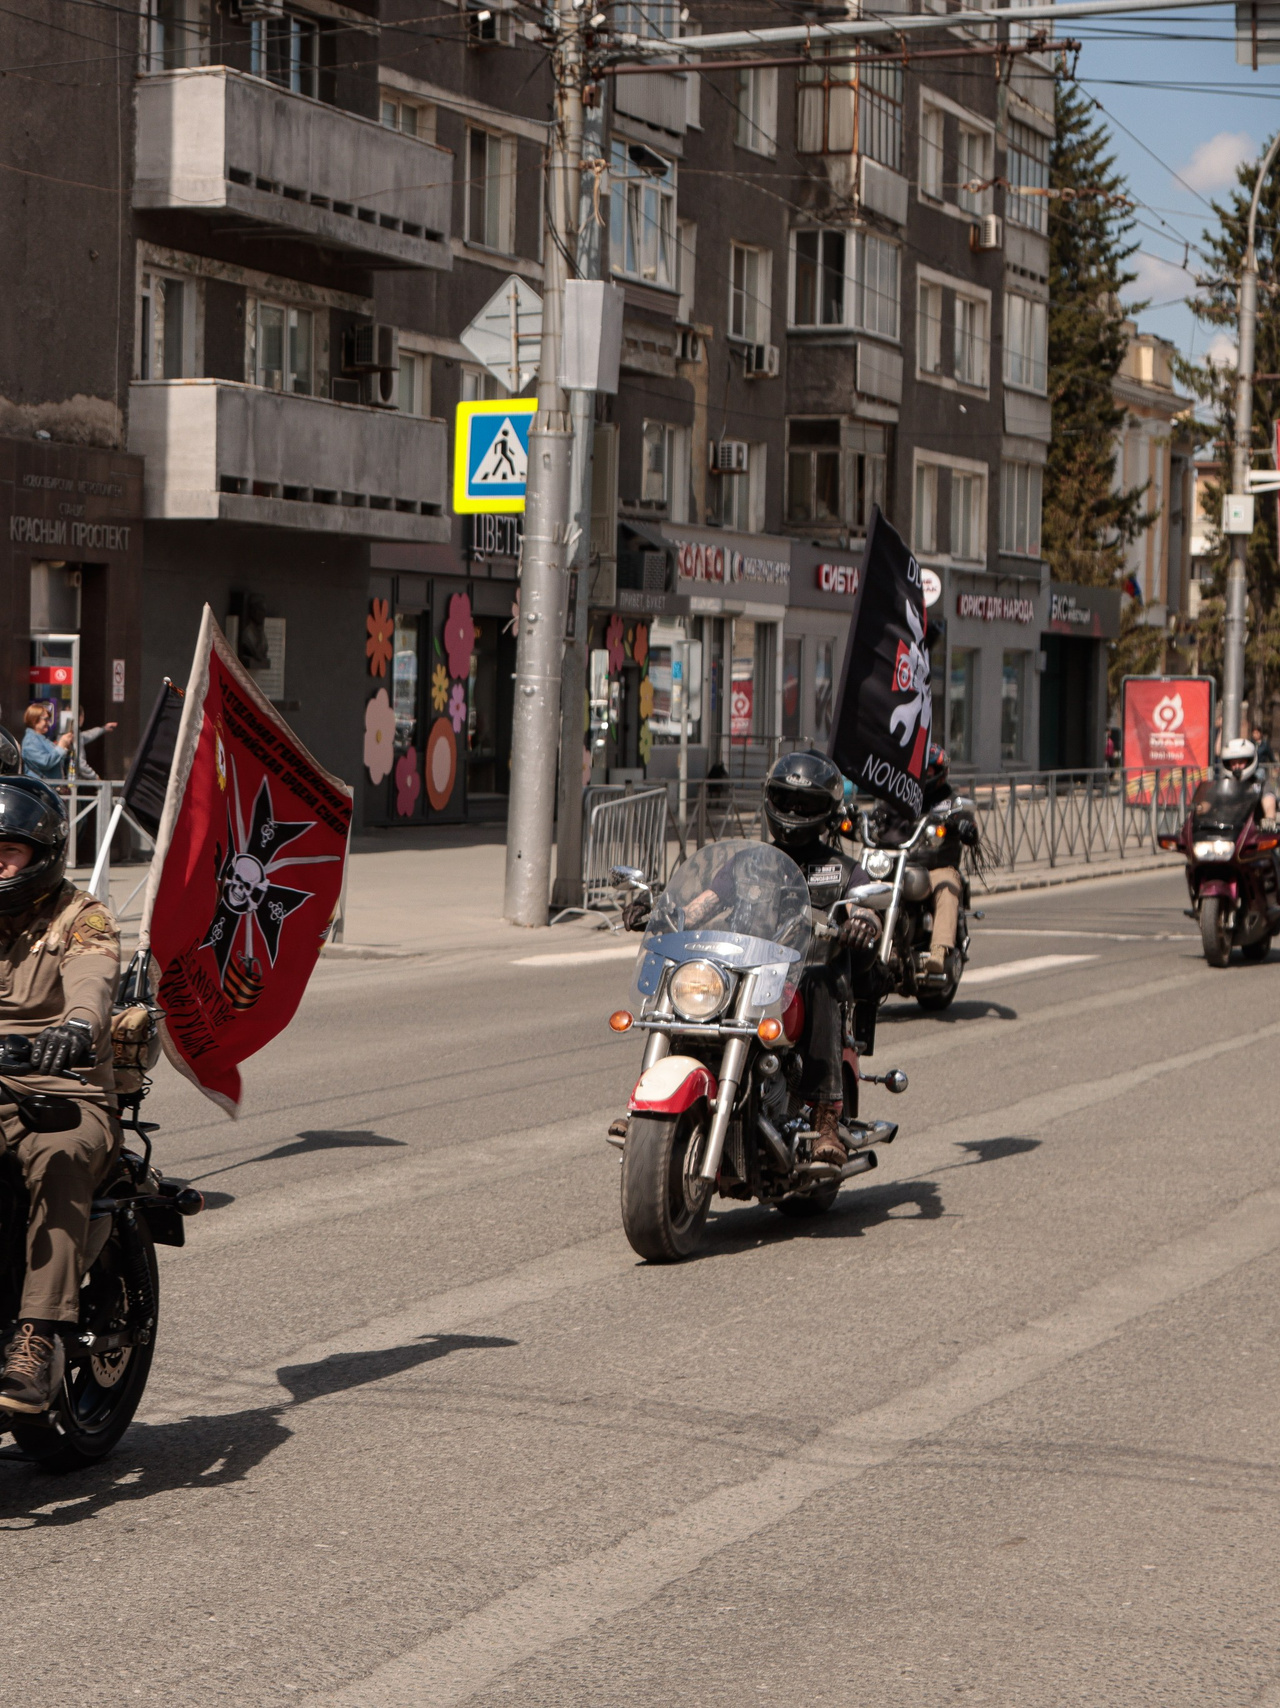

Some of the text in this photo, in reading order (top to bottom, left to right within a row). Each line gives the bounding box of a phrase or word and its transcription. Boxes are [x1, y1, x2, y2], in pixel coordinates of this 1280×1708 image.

[10, 515, 131, 550] КРАСНЫЙ ПРОСПЕКТ
[960, 594, 1035, 624] ЮРИСТ ДЛЯ НАРОДА
[1051, 594, 1069, 621] БКС
[273, 741, 344, 809] ГВАРДЕЙСКАЯ
[280, 770, 320, 809] ОРДЕНА
